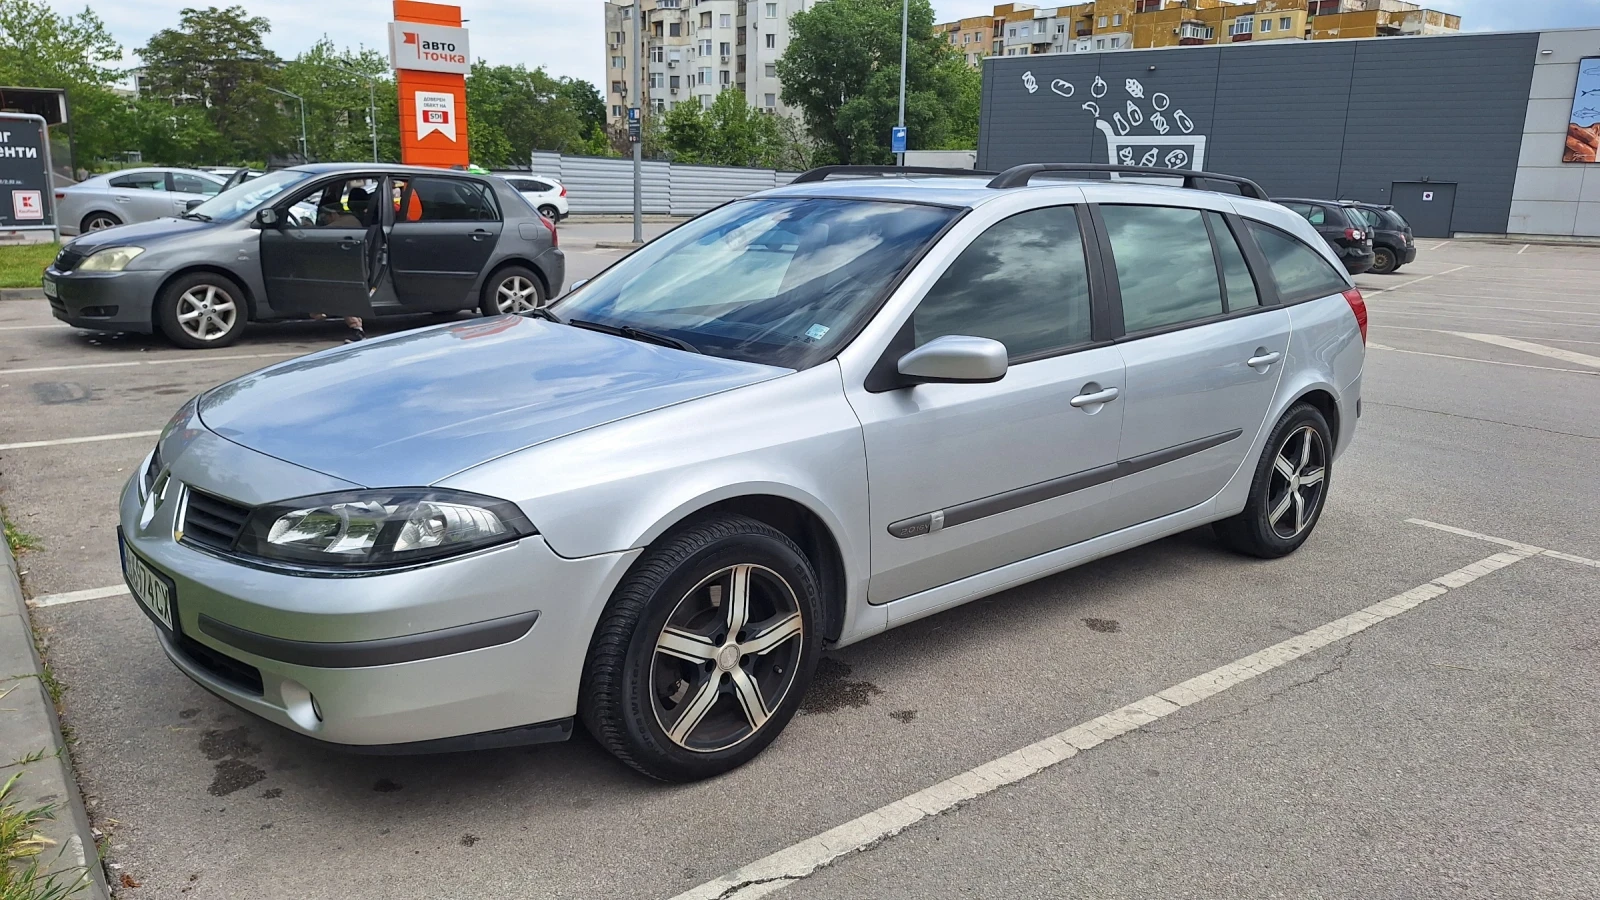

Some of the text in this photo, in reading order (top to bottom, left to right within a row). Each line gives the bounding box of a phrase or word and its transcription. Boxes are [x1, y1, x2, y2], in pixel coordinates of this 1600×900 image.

[422, 41, 455, 52] авто
[423, 52, 465, 63] точка
[0, 131, 11, 142] г
